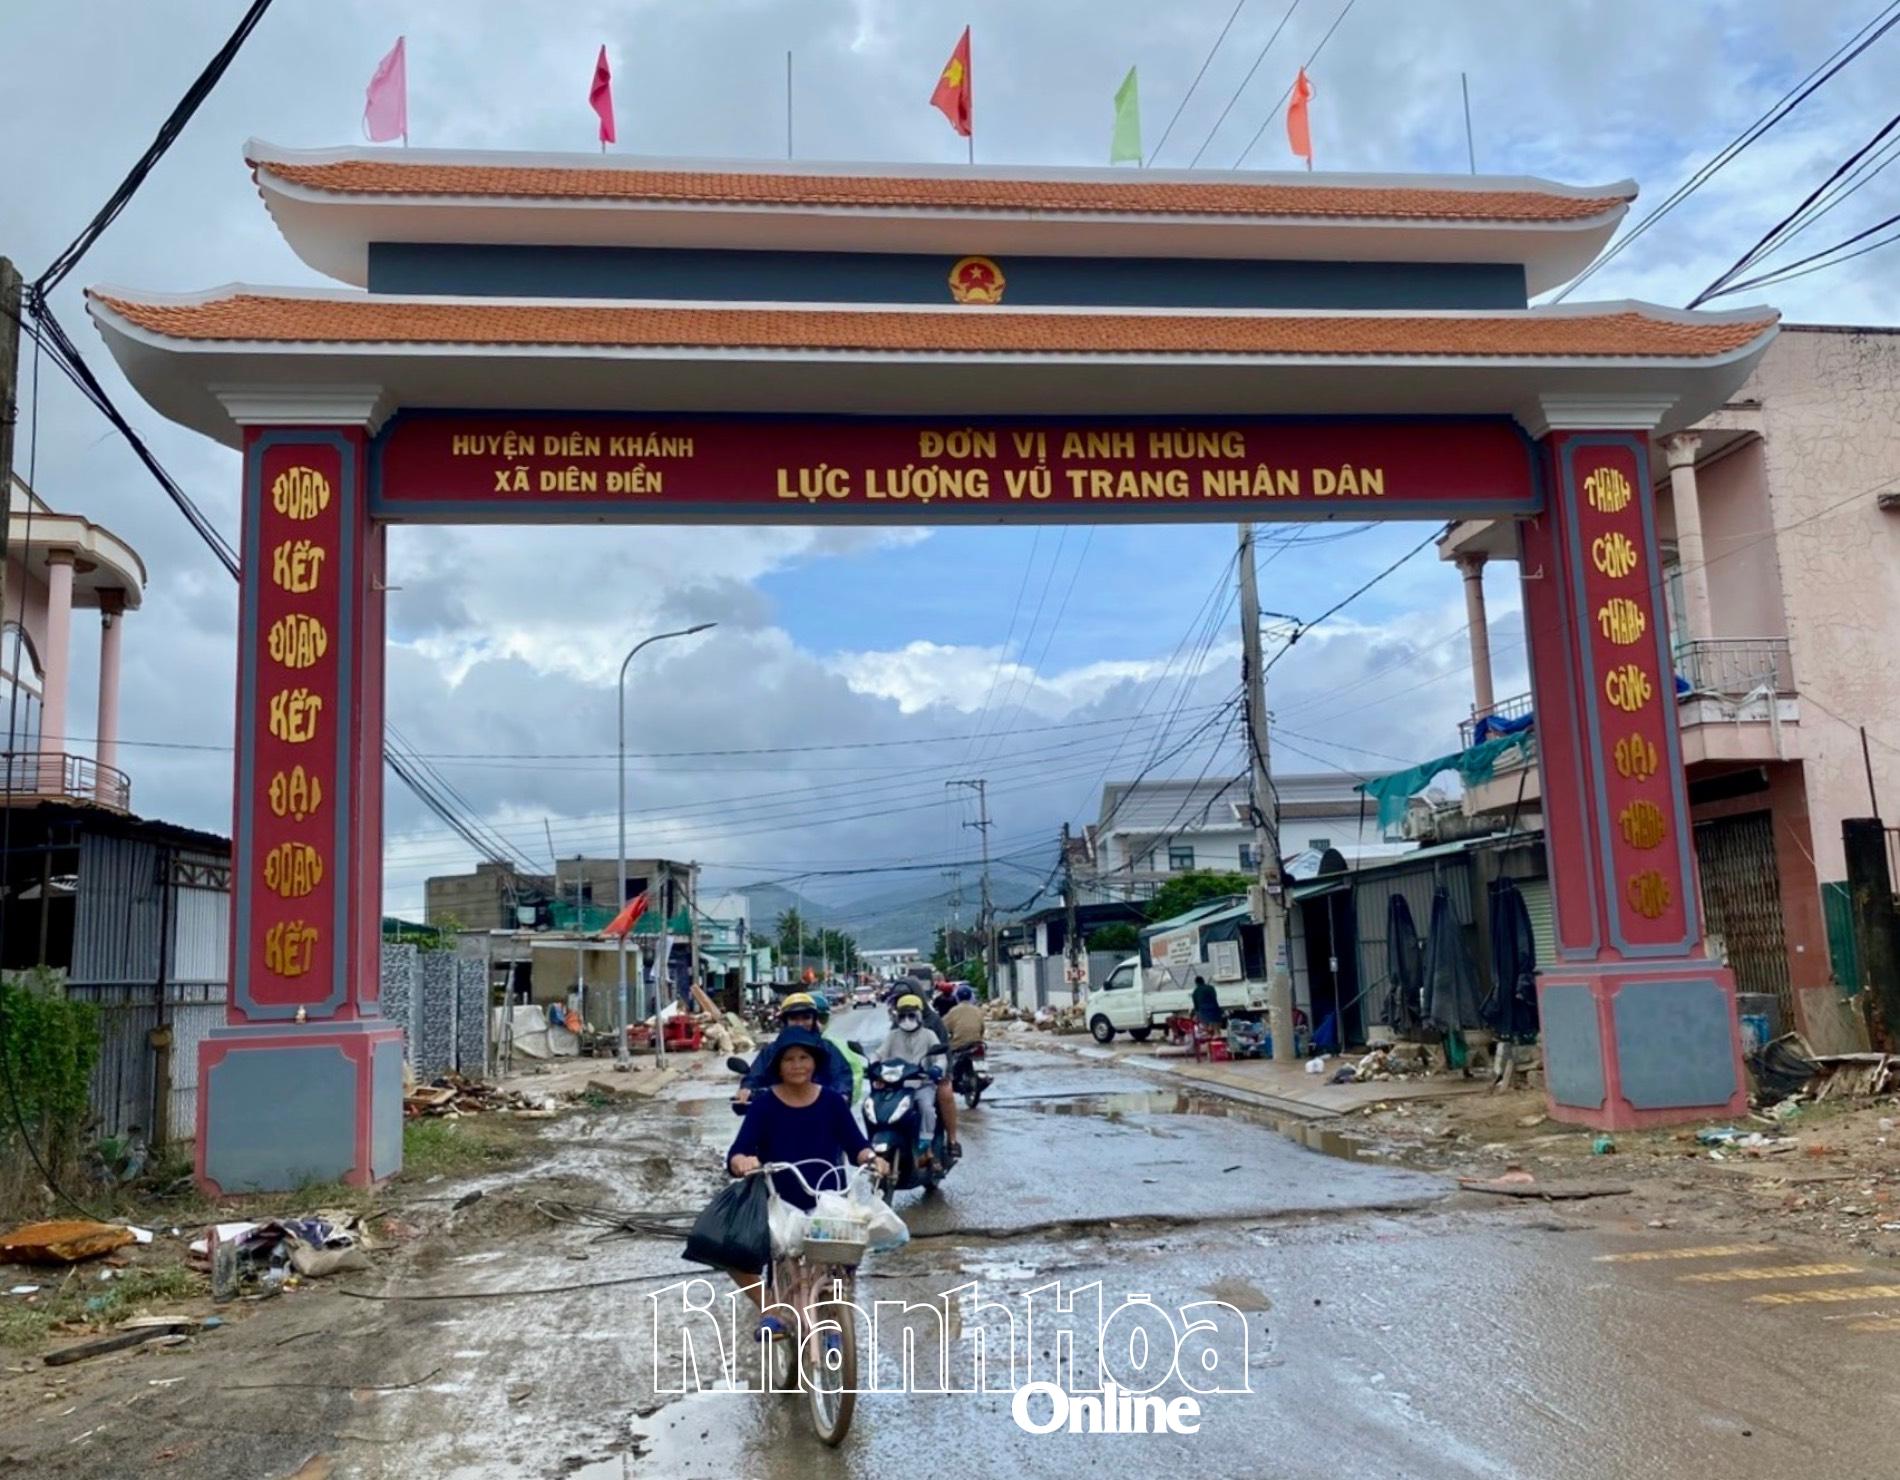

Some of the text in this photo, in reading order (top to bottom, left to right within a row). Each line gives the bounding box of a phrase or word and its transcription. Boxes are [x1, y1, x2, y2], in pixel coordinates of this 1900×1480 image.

[452, 430, 694, 460] HUYỆN DIÊN KHÁNH
[918, 427, 1246, 463] ĐƠN VỊ ANH HÙNG
[493, 462, 663, 493] XÃ DIÊN ĐIỀN
[776, 462, 1385, 504] LỰC LƯỢNG VŨ TRANG NHÂN DÂN
[1583, 467, 1632, 513] THÀNH
[1591, 531, 1637, 579] CÔNG
[1597, 598, 1646, 645] THÀNH
[1605, 663, 1652, 712] CÔNG
[264, 466, 331, 977] ĐOÀN KẾT ĐOÀN KẾT ĐẠI ĐOÀN KẾT
[1614, 732, 1658, 782] ĐẠI
